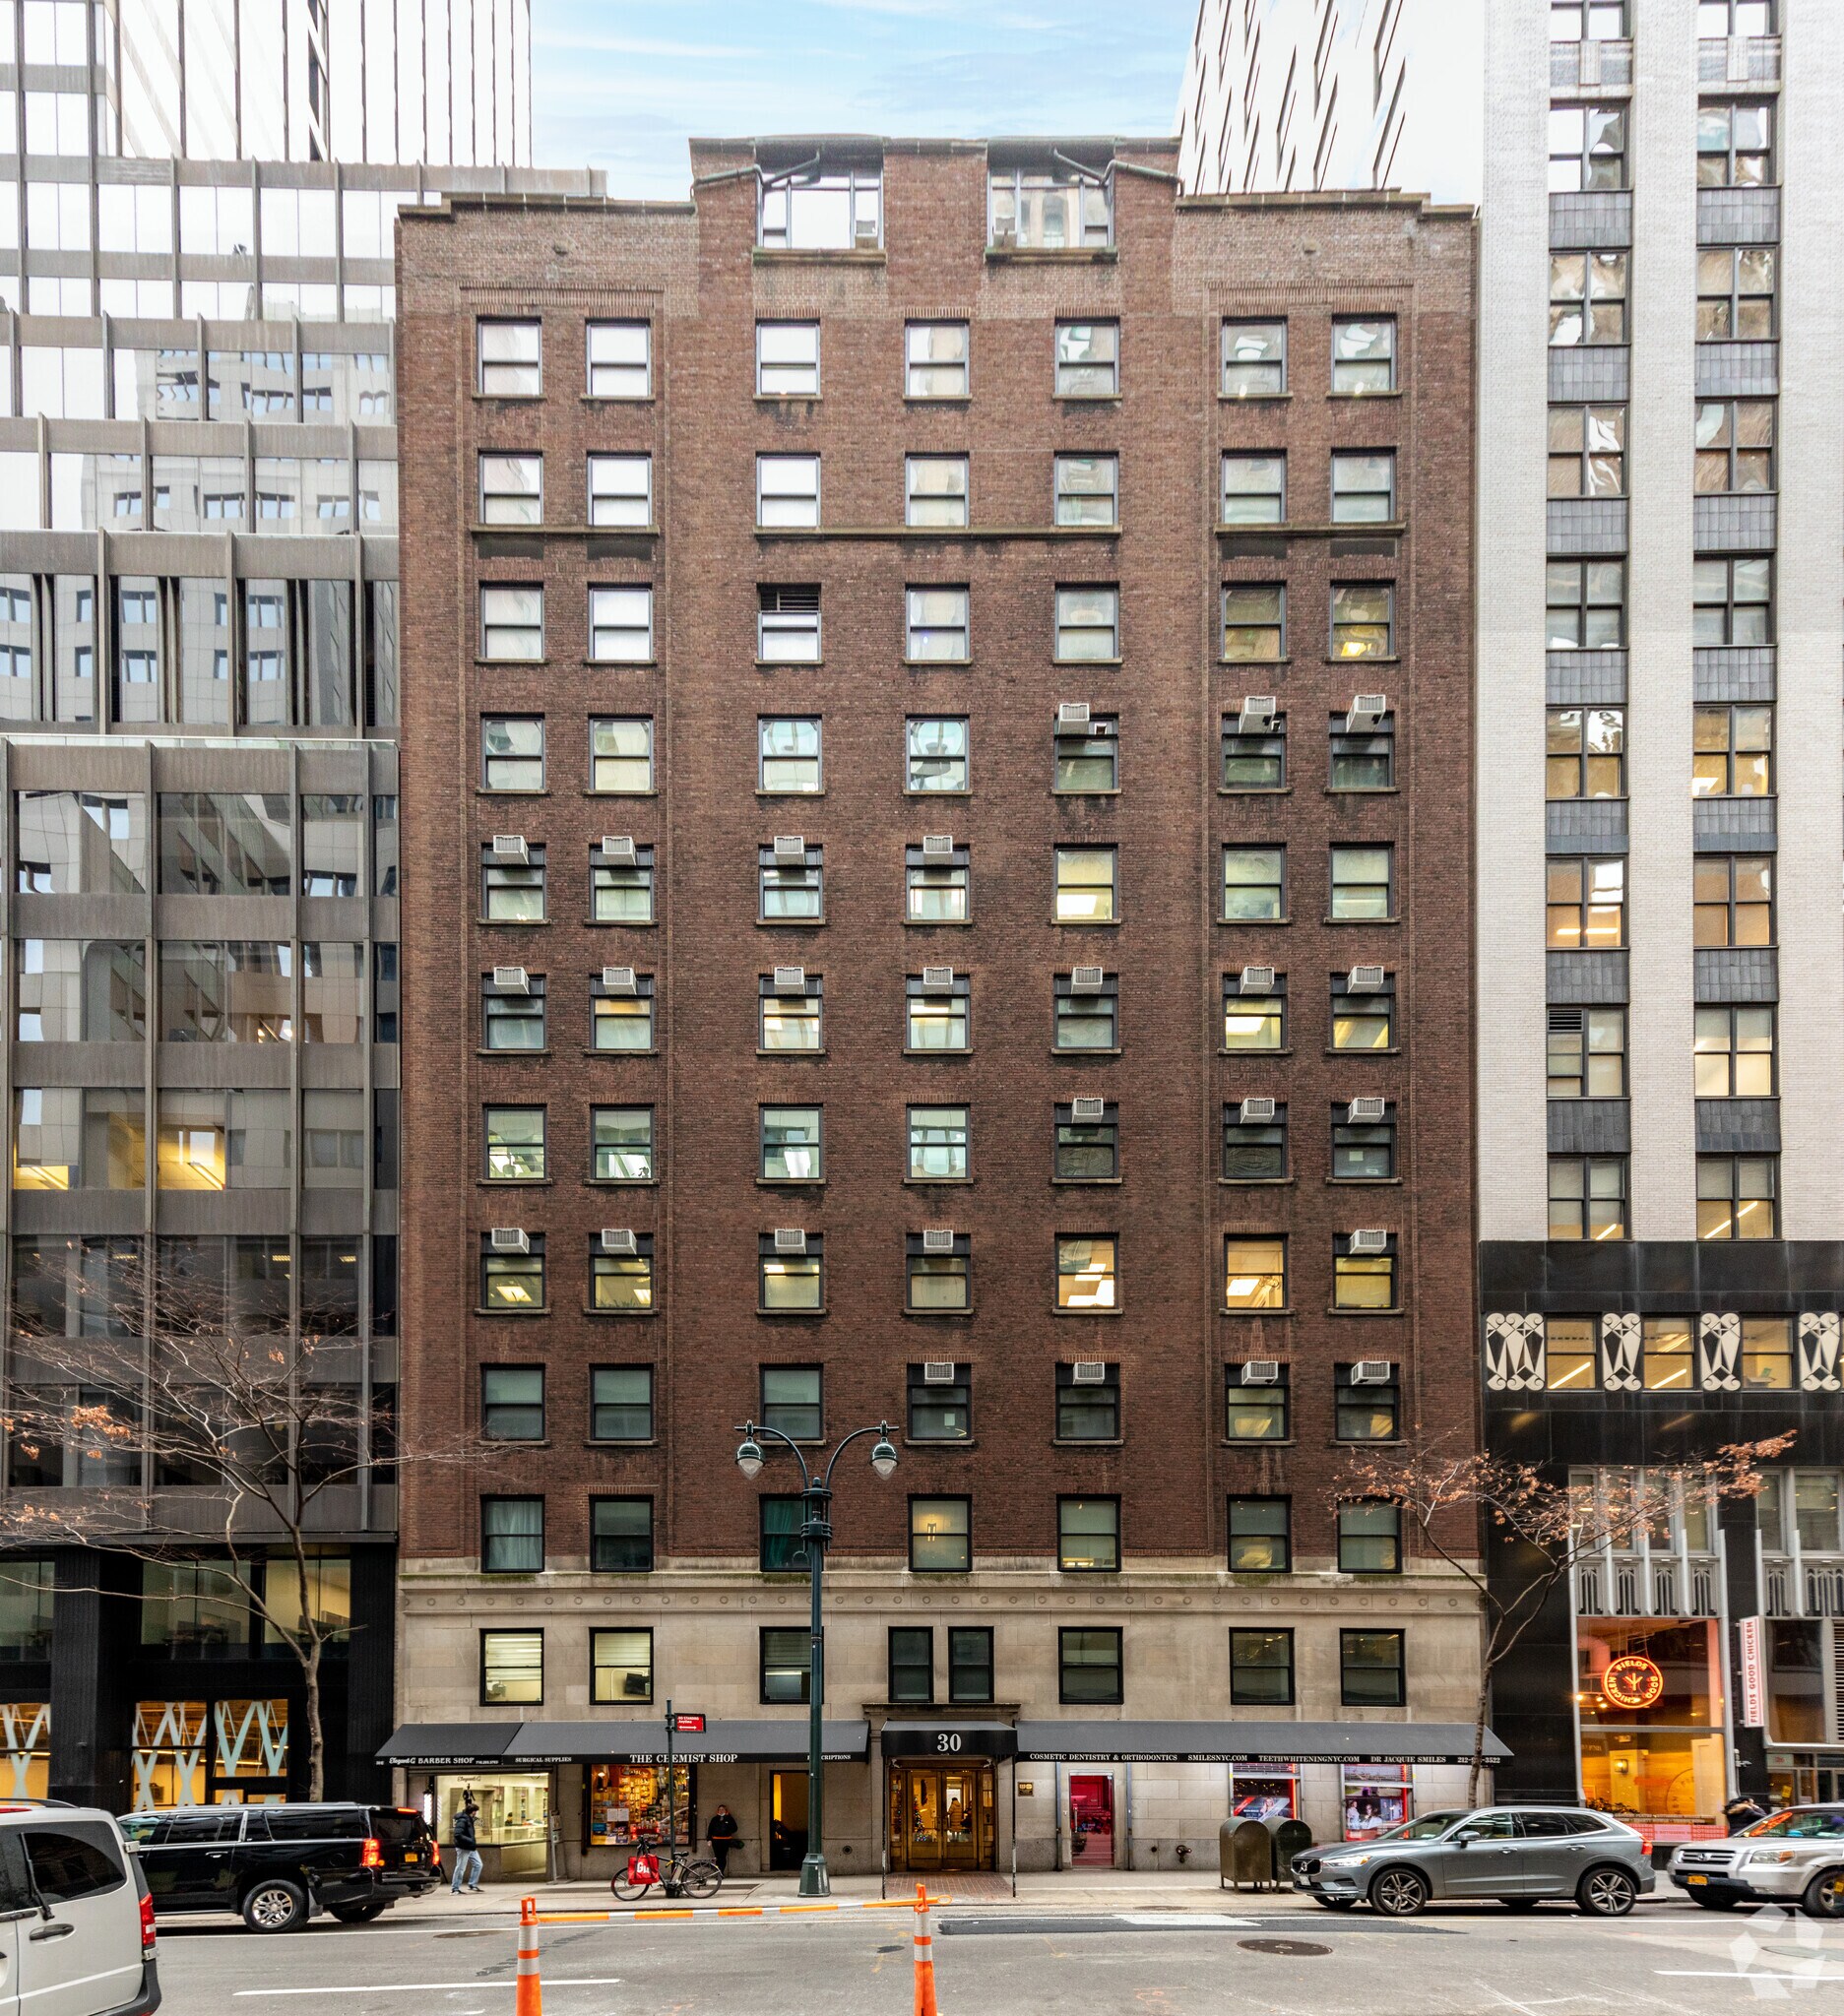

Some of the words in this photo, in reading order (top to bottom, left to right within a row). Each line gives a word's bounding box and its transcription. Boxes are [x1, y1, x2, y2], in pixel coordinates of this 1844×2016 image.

[1746, 1621, 1754, 1661] CHICKEN
[1616, 1660, 1648, 1671] FIELDS
[1645, 1675, 1659, 1699] GOOD
[1748, 1664, 1756, 1690] GOOD
[937, 1733, 962, 1751] 30
[629, 1754, 653, 1763] THE
[709, 1754, 738, 1763] SHOP
